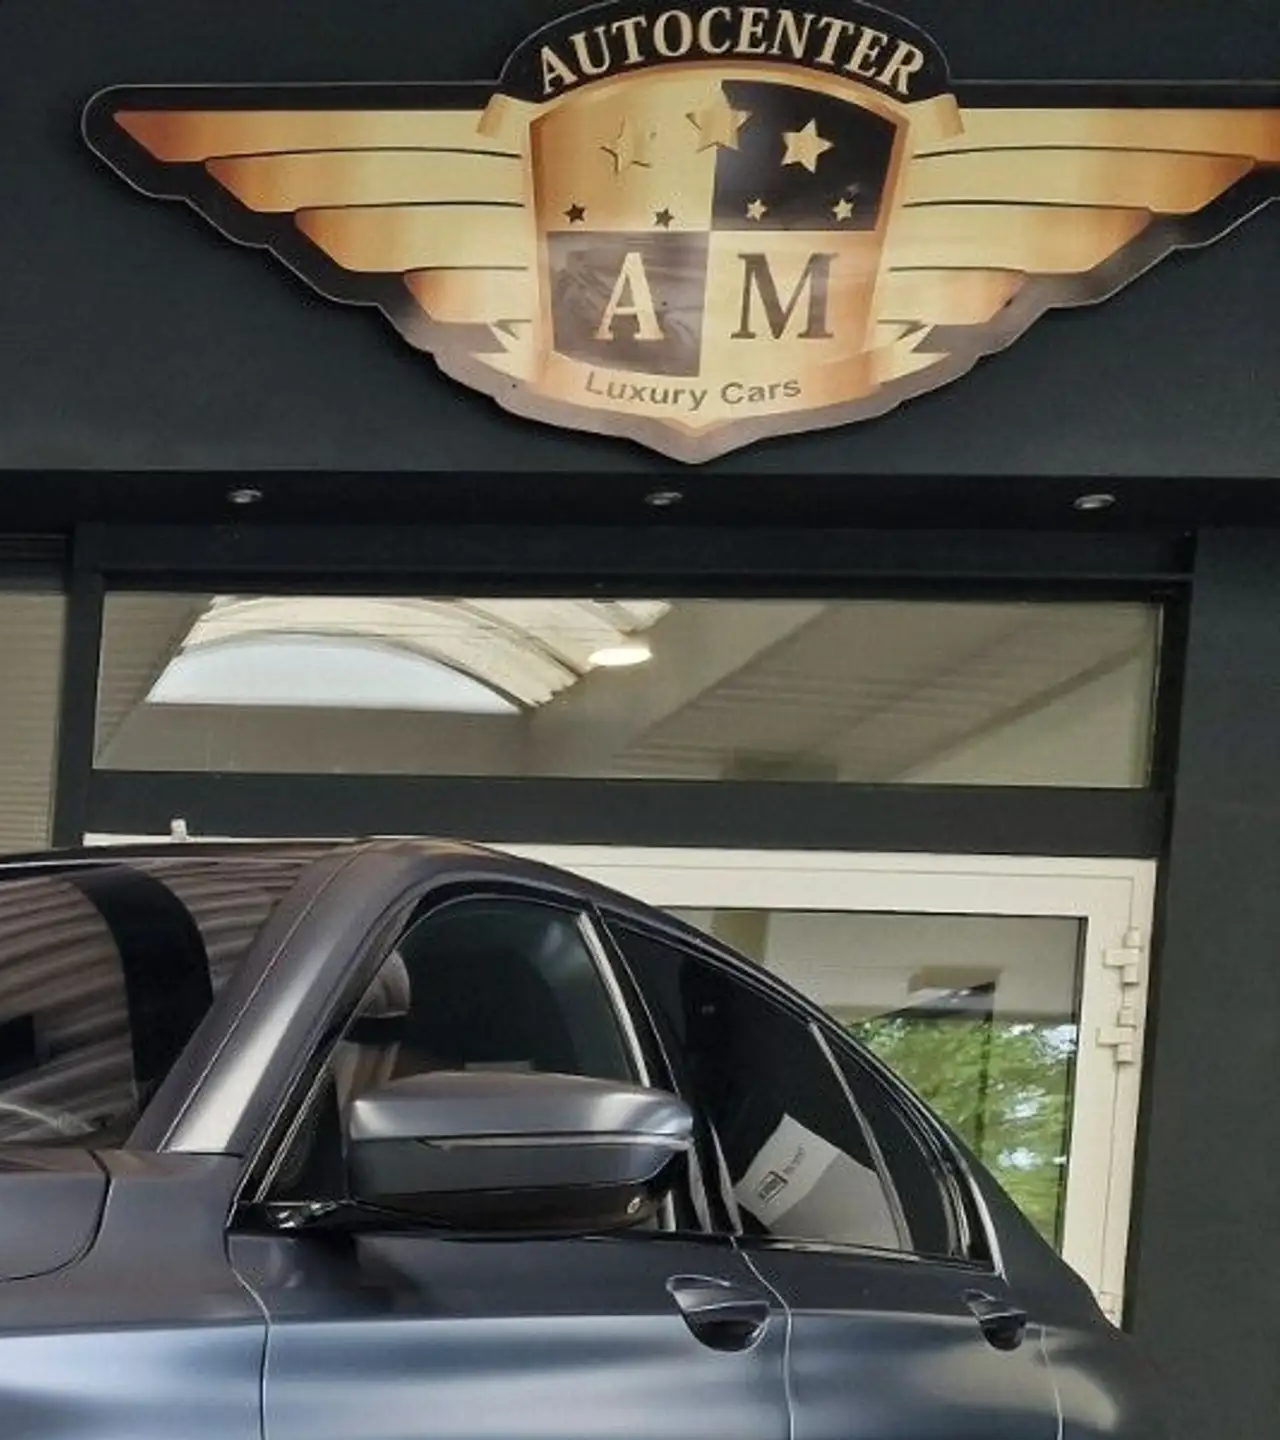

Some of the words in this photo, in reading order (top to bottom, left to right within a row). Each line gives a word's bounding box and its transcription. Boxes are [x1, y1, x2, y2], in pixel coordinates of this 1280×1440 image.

[540, 7, 925, 95] AUTOCENTER
[592, 252, 665, 341] A
[730, 252, 839, 339] M
[585, 371, 708, 412] Luxury
[720, 378, 802, 405] Cars
